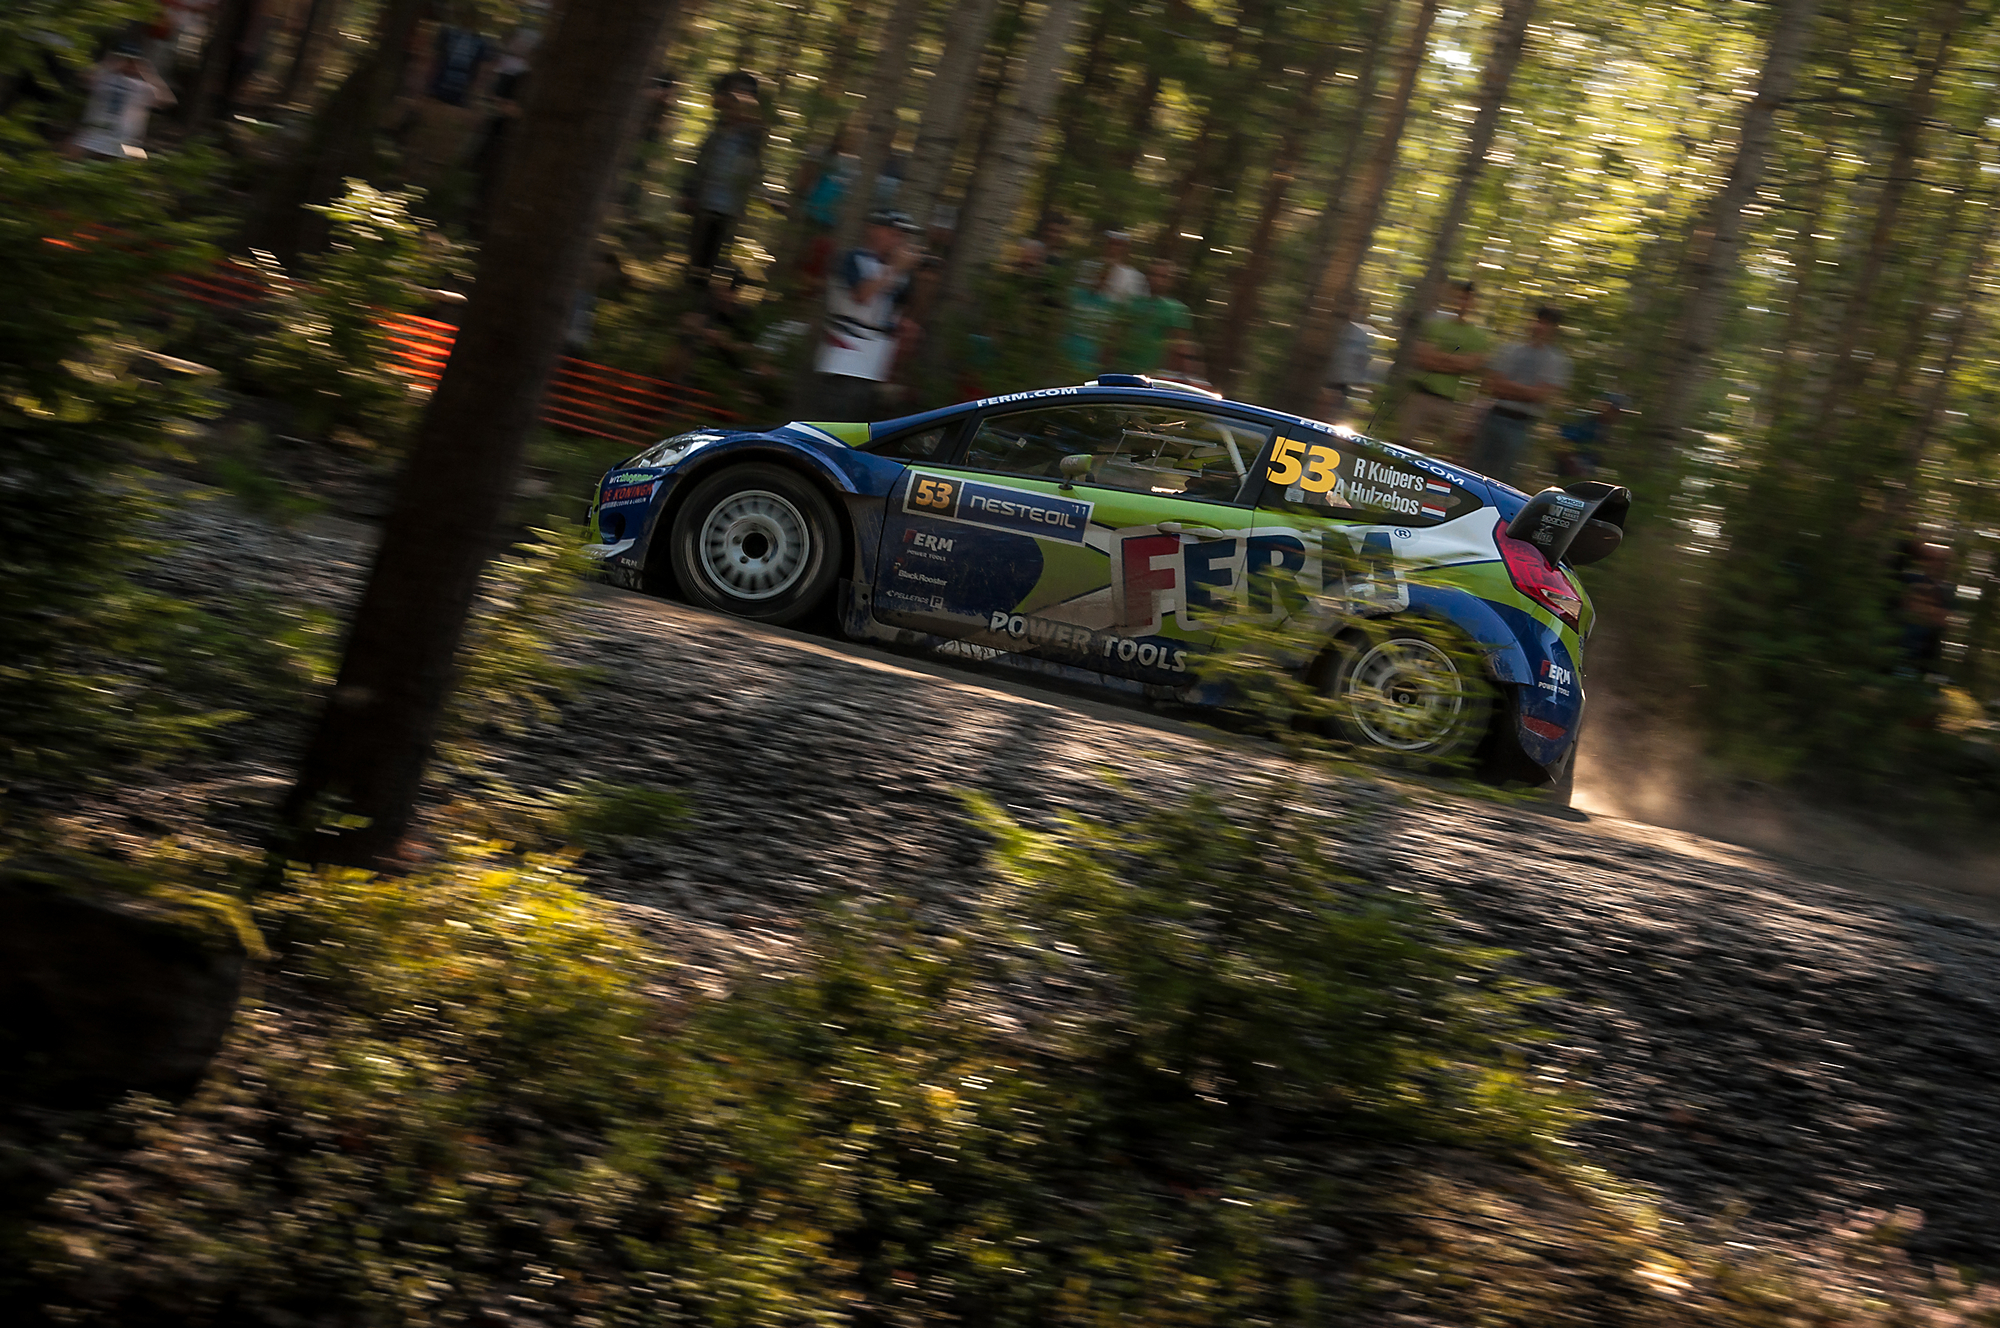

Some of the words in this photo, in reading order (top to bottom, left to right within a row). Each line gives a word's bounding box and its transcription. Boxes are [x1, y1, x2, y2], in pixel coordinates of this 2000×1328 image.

[976, 386, 1078, 407] FERM.COM
[1266, 435, 1341, 493] 53
[1353, 457, 1366, 478] R
[1368, 461, 1425, 492] Kuipers
[915, 479, 953, 510] 53
[969, 495, 1077, 529] NESTEOIL
[1333, 478, 1346, 498] A
[1349, 481, 1420, 516] Hulzebos
[903, 528, 954, 553] FERM
[1120, 530, 1400, 629] FERM
[989, 610, 1092, 655] POWER
[1099, 634, 1188, 674] TOOLS
[1537, 681, 1558, 693] POWER
[1540, 659, 1571, 685] FERM
